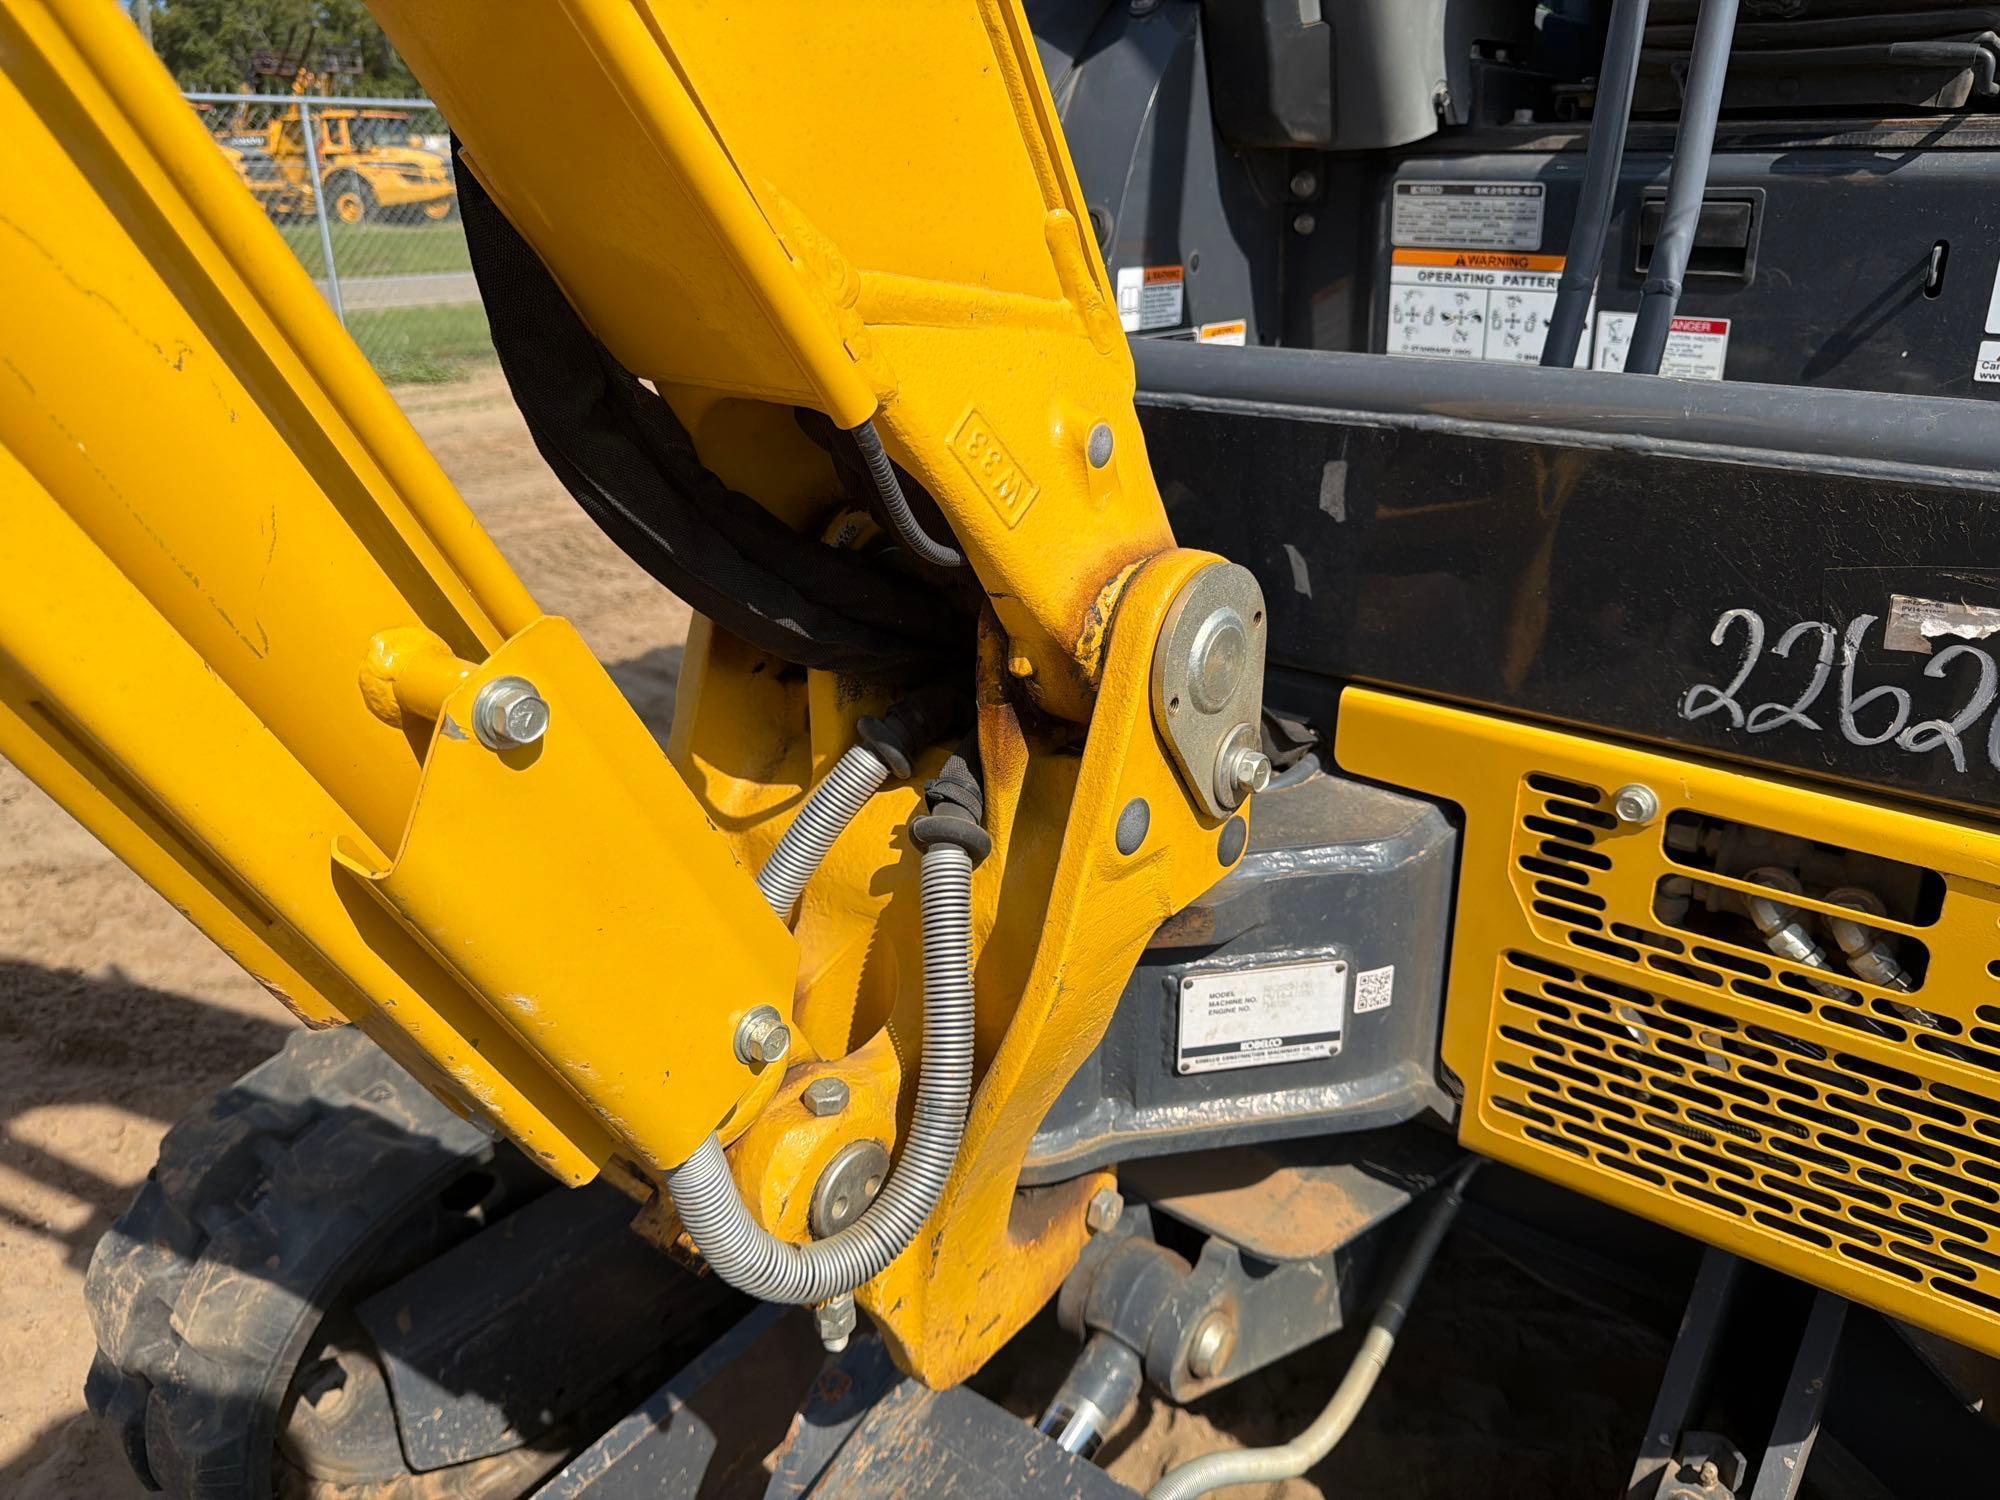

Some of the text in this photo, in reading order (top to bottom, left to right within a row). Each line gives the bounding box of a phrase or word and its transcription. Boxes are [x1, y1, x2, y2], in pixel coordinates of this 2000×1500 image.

[1468, 256, 1529, 269] WARNING
[1417, 270, 1557, 289] OPERATING PATTER
[1670, 319, 1711, 333] ANGER
[1208, 991, 1235, 1000] MODEL
[1208, 998, 1243, 1008] MACHINE
[1207, 1005, 1251, 1016] ENGINE NO.
[1240, 1038, 1283, 1051] KOBELCO
